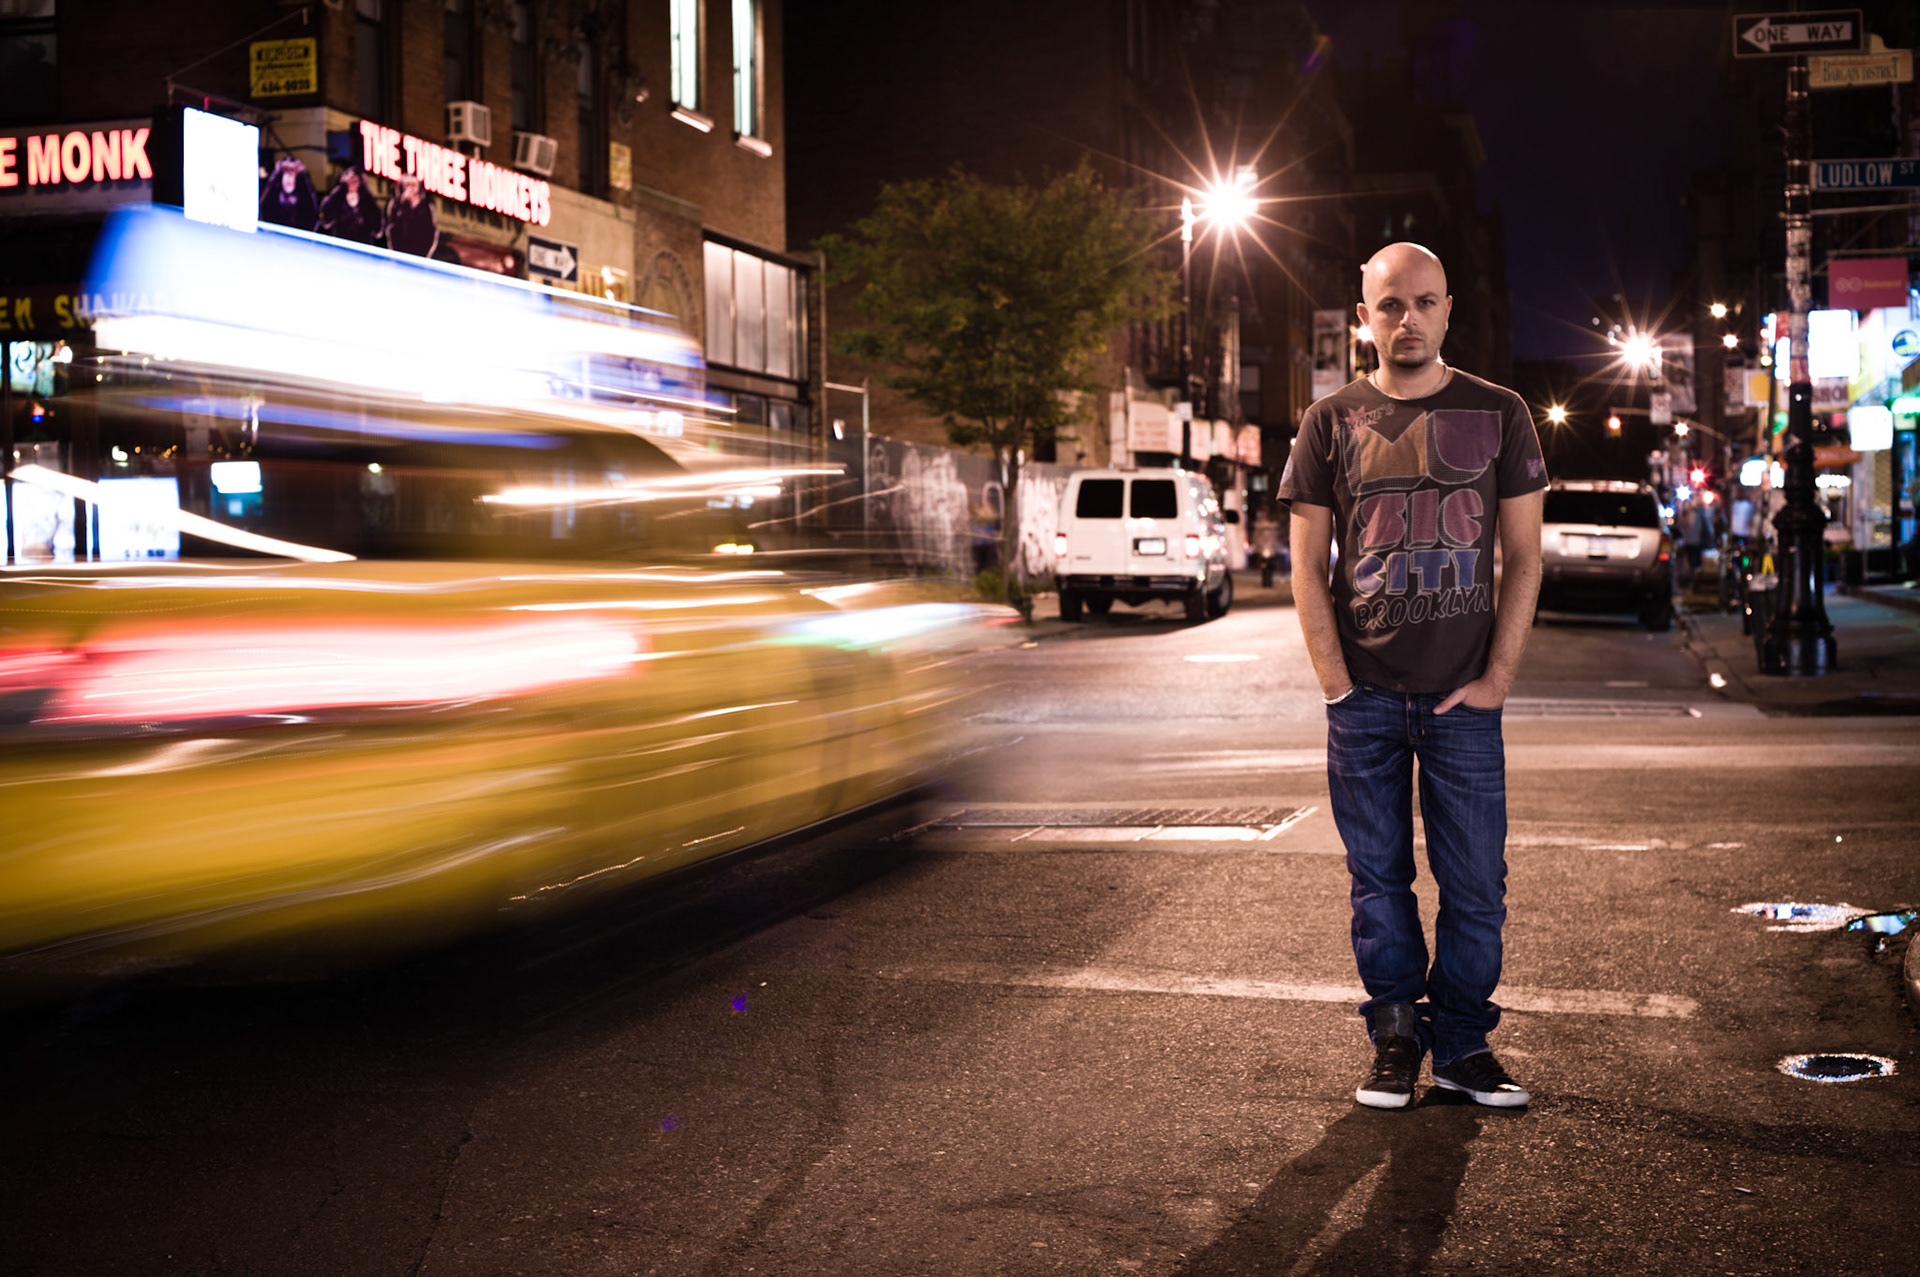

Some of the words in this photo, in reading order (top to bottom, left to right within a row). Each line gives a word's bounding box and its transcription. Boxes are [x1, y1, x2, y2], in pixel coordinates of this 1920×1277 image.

[1754, 27, 1790, 43] ONE
[1807, 23, 1844, 40] WAY
[27, 127, 153, 187] MONK
[359, 119, 402, 182] THE
[403, 134, 467, 202] THREE
[468, 158, 551, 227] MONKEYS
[1818, 163, 1894, 187] LUDLOW
[1900, 162, 1915, 174] ST
[1353, 549, 1481, 598] CITY
[1354, 582, 1490, 631] BROOKLYN
